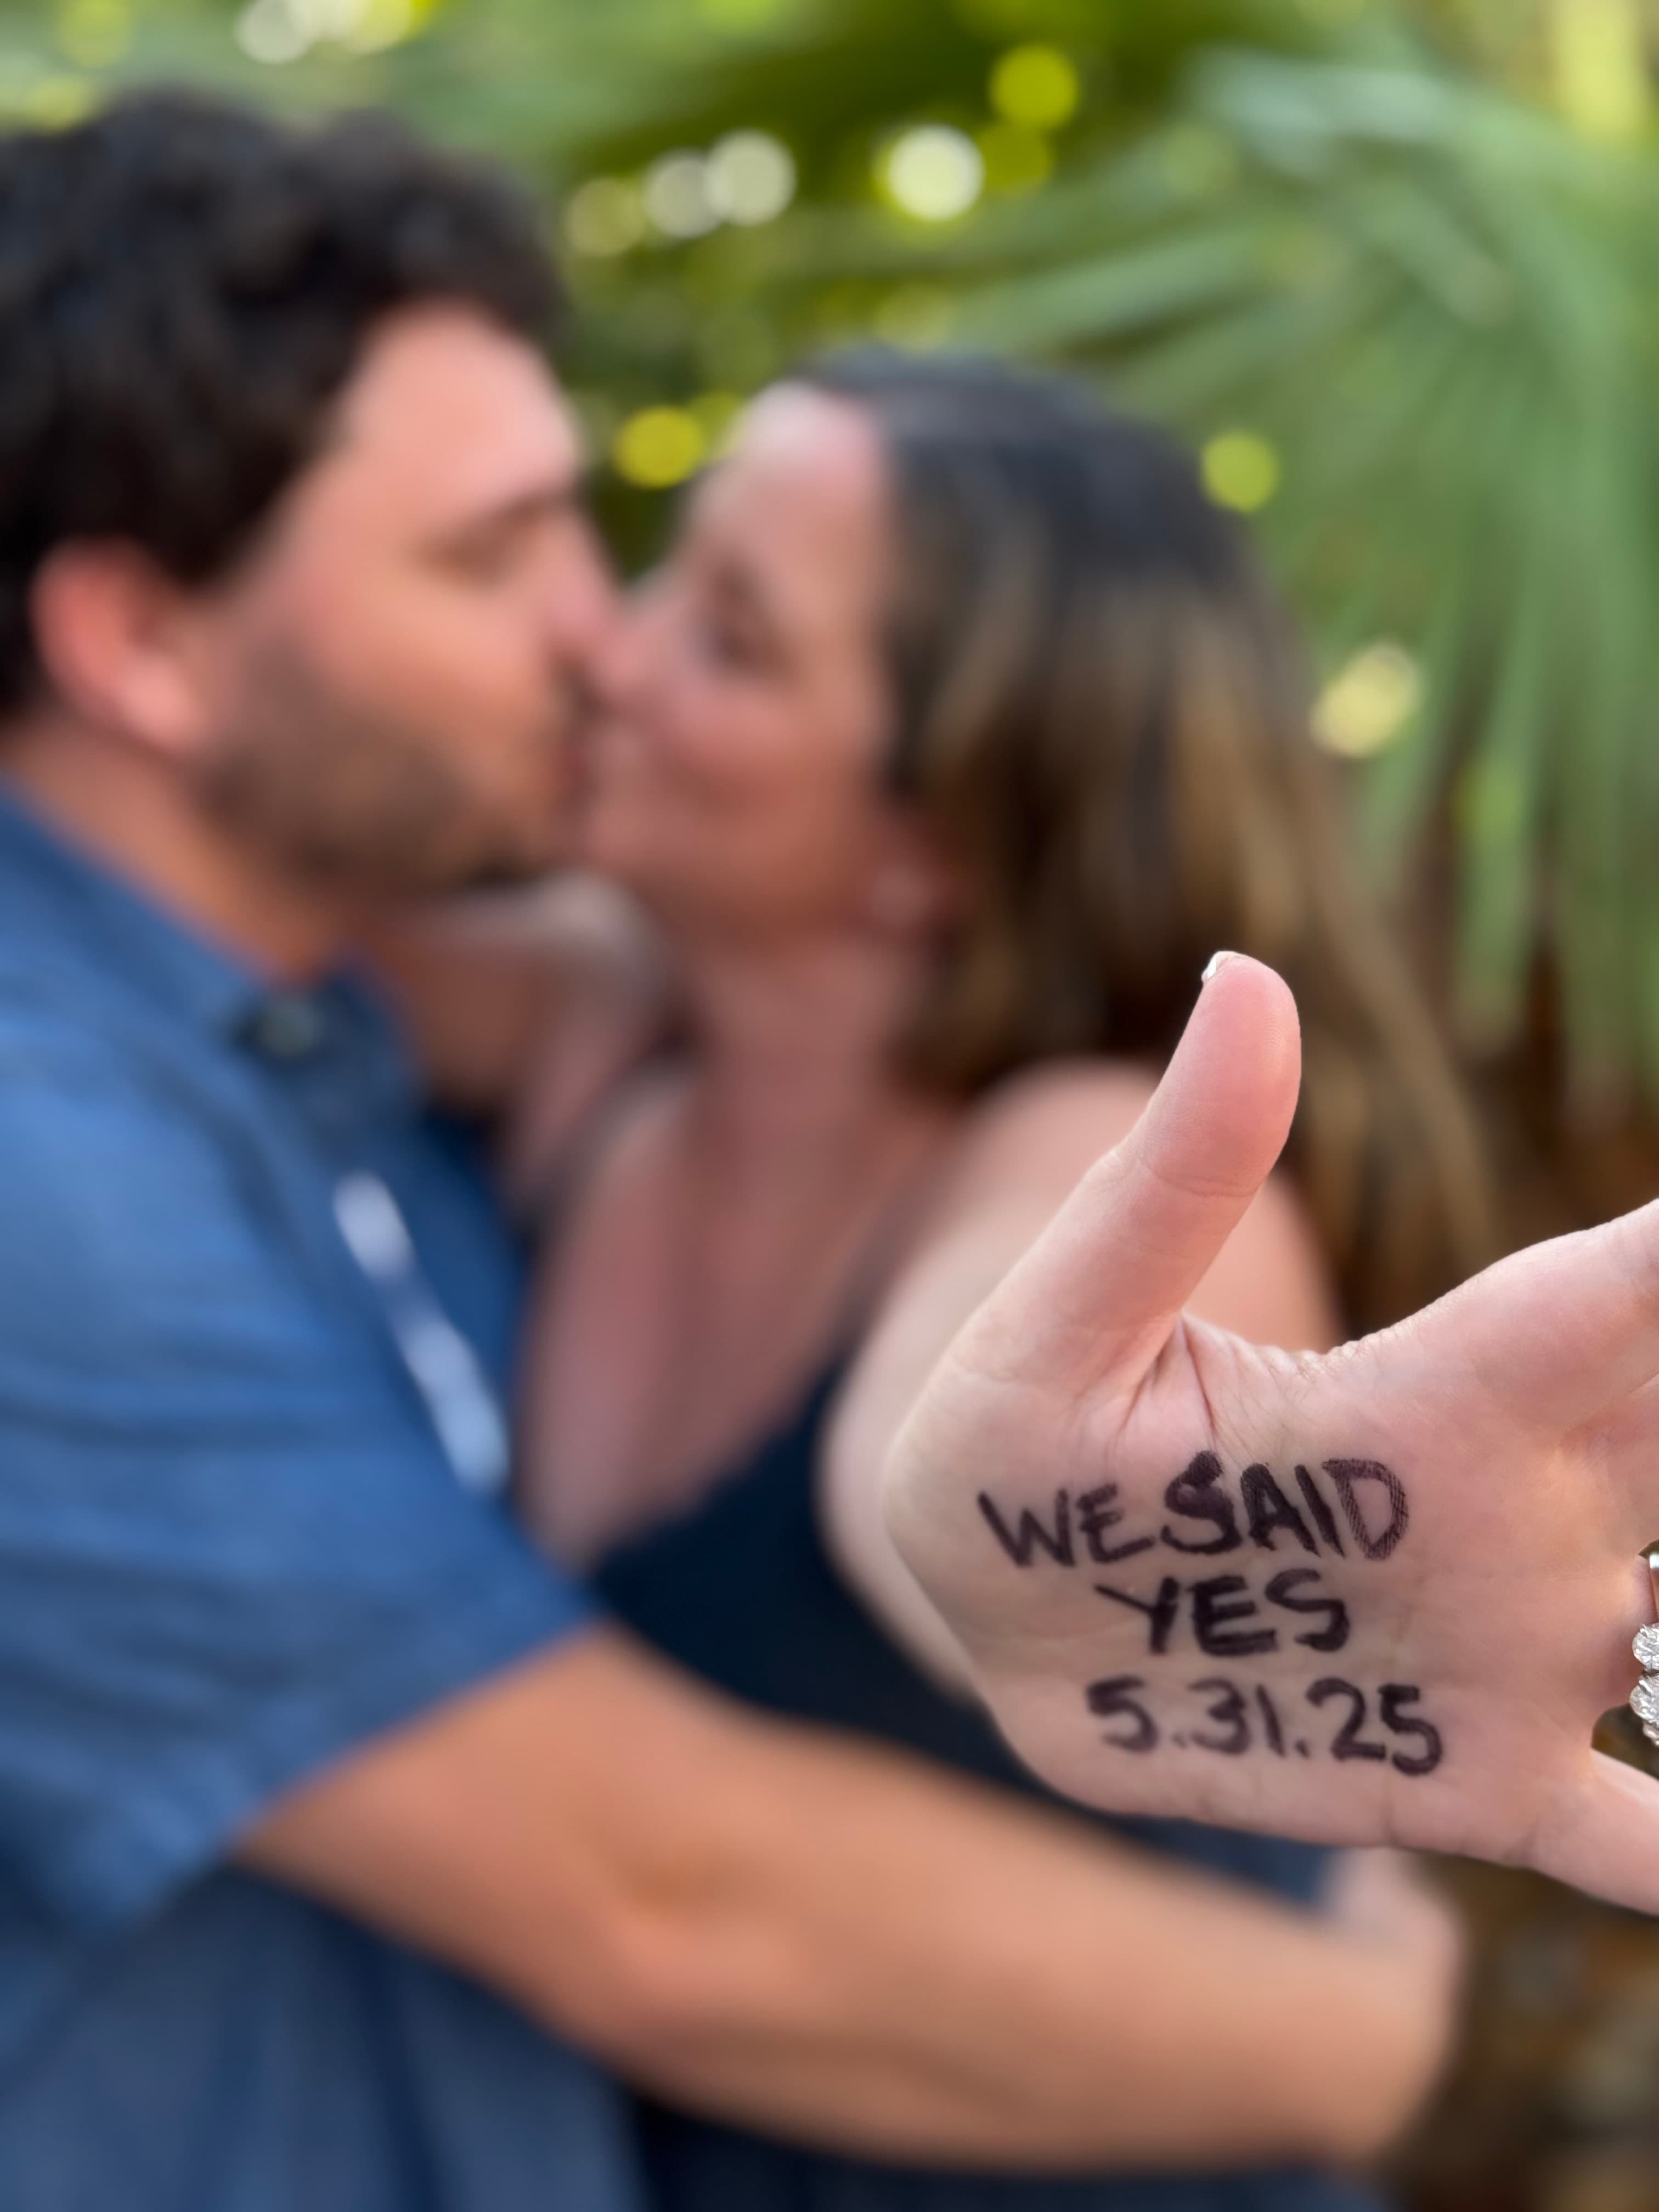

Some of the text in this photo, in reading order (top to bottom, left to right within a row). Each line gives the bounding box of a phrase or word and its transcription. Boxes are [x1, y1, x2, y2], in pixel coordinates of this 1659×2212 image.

[977, 1450, 1409, 1567] WE SAID
[1094, 1568, 1351, 1656] YES
[1086, 1675, 1444, 1776] 5.31.25
